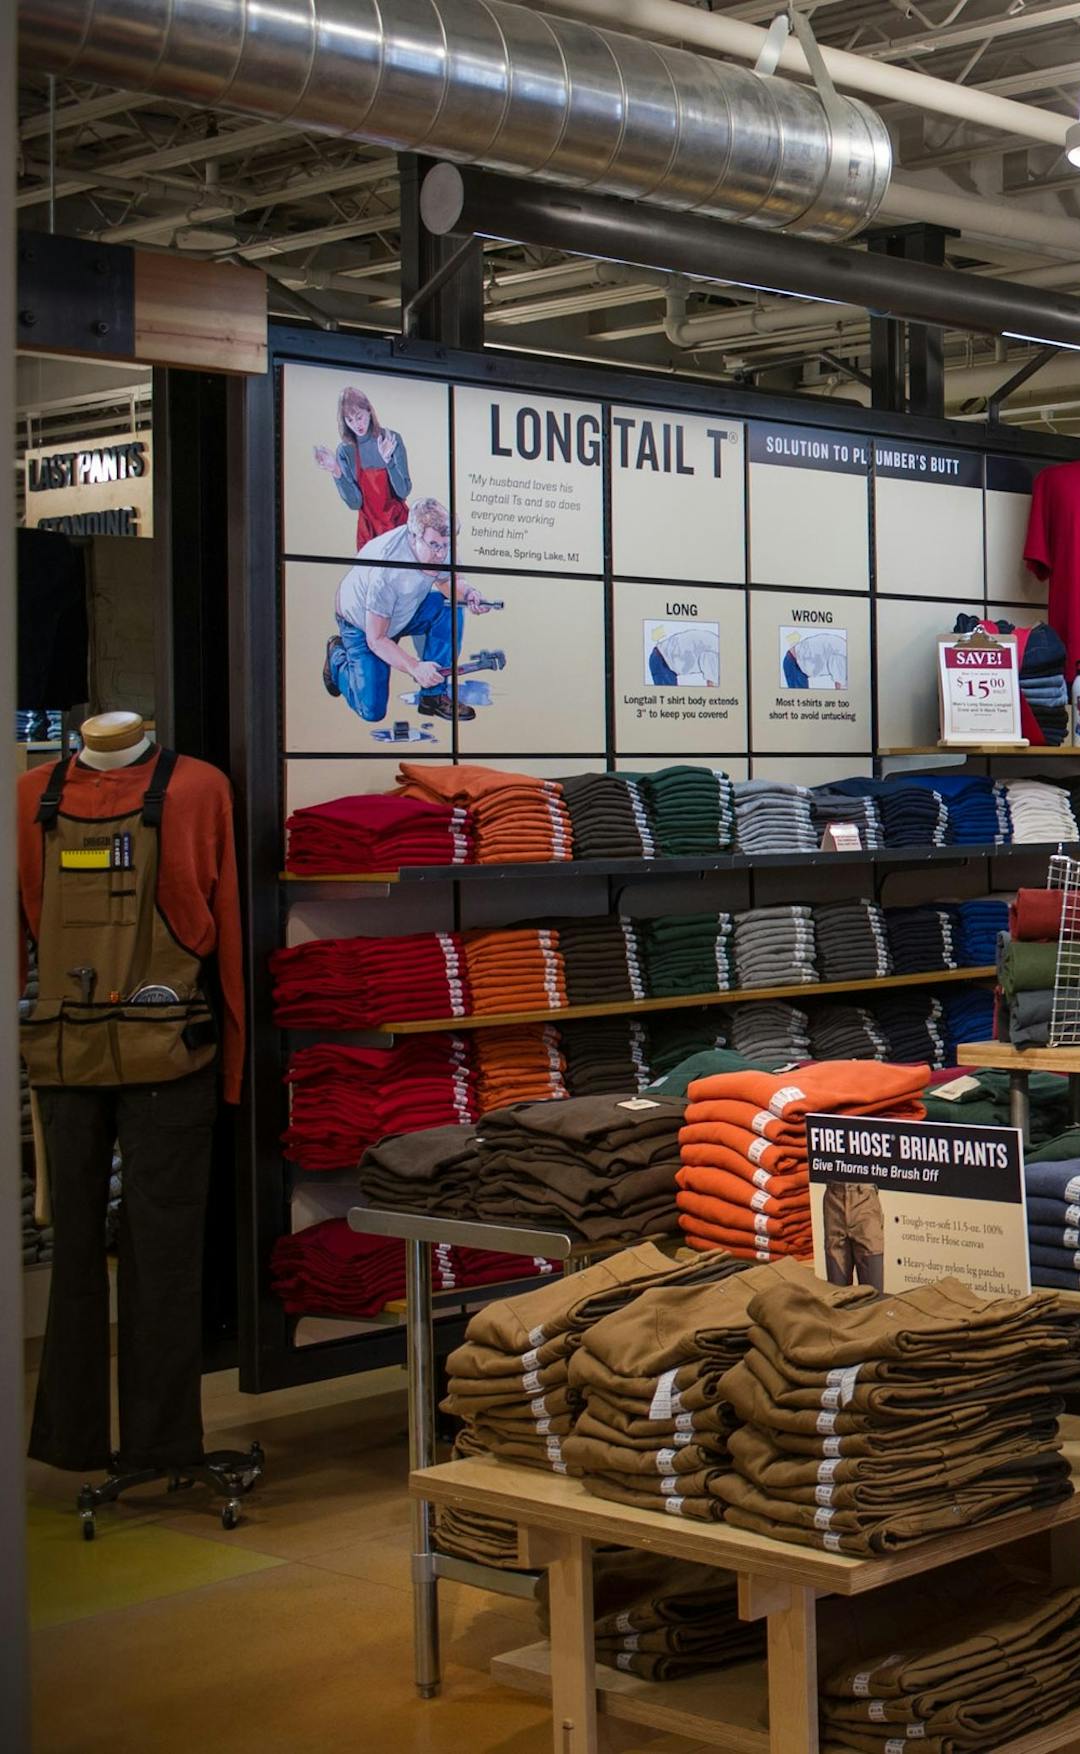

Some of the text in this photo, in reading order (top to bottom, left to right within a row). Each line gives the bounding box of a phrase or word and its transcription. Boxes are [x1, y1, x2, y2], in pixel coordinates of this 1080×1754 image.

[766, 436, 960, 475] SOLUTION TO PLUMBER'S BUTT
[29, 442, 145, 492] LAST PANTS
[489, 475, 531, 490] husband
[533, 480, 557, 493] loves
[560, 481, 574, 493] his
[471, 491, 509, 506] Longtail
[525, 496, 543, 508] and
[545, 499, 556, 509] so
[559, 499, 581, 512] does
[471, 510, 555, 528] everyone working
[471, 525, 504, 539] behind
[514, 549, 542, 562] Spring
[544, 551, 566, 562] Lake,
[568, 552, 579, 562] MI
[666, 602, 698, 617] LONG
[792, 609, 833, 624] WRONG
[956, 651, 1002, 665] SAVE!
[624, 695, 739, 707] Longtail T shirt body extends
[776, 697, 794, 707] Most
[797, 698, 822, 708] t-shirts
[838, 700, 850, 708] too
[649, 710, 657, 718] to
[660, 709, 680, 720] keep
[682, 711, 696, 720] you
[698, 710, 728, 719] covered
[769, 711, 856, 722] short to avoid untucking
[810, 1127, 846, 1154] FIRE
[899, 1135, 950, 1164] BRIAR
[953, 1139, 1008, 1169] PANTS
[812, 1157, 939, 1182] Give Thorns the Brush Off
[983, 1223, 1004, 1235] 100%
[901, 1232, 984, 1249] cotton Fire Hose canvas
[903, 1257, 1005, 1278] Heavy-duty nylon leg patches
[975, 1281, 987, 1292] and
[989, 1282, 1006, 1294] back
[1007, 1284, 1021, 1298] legs
